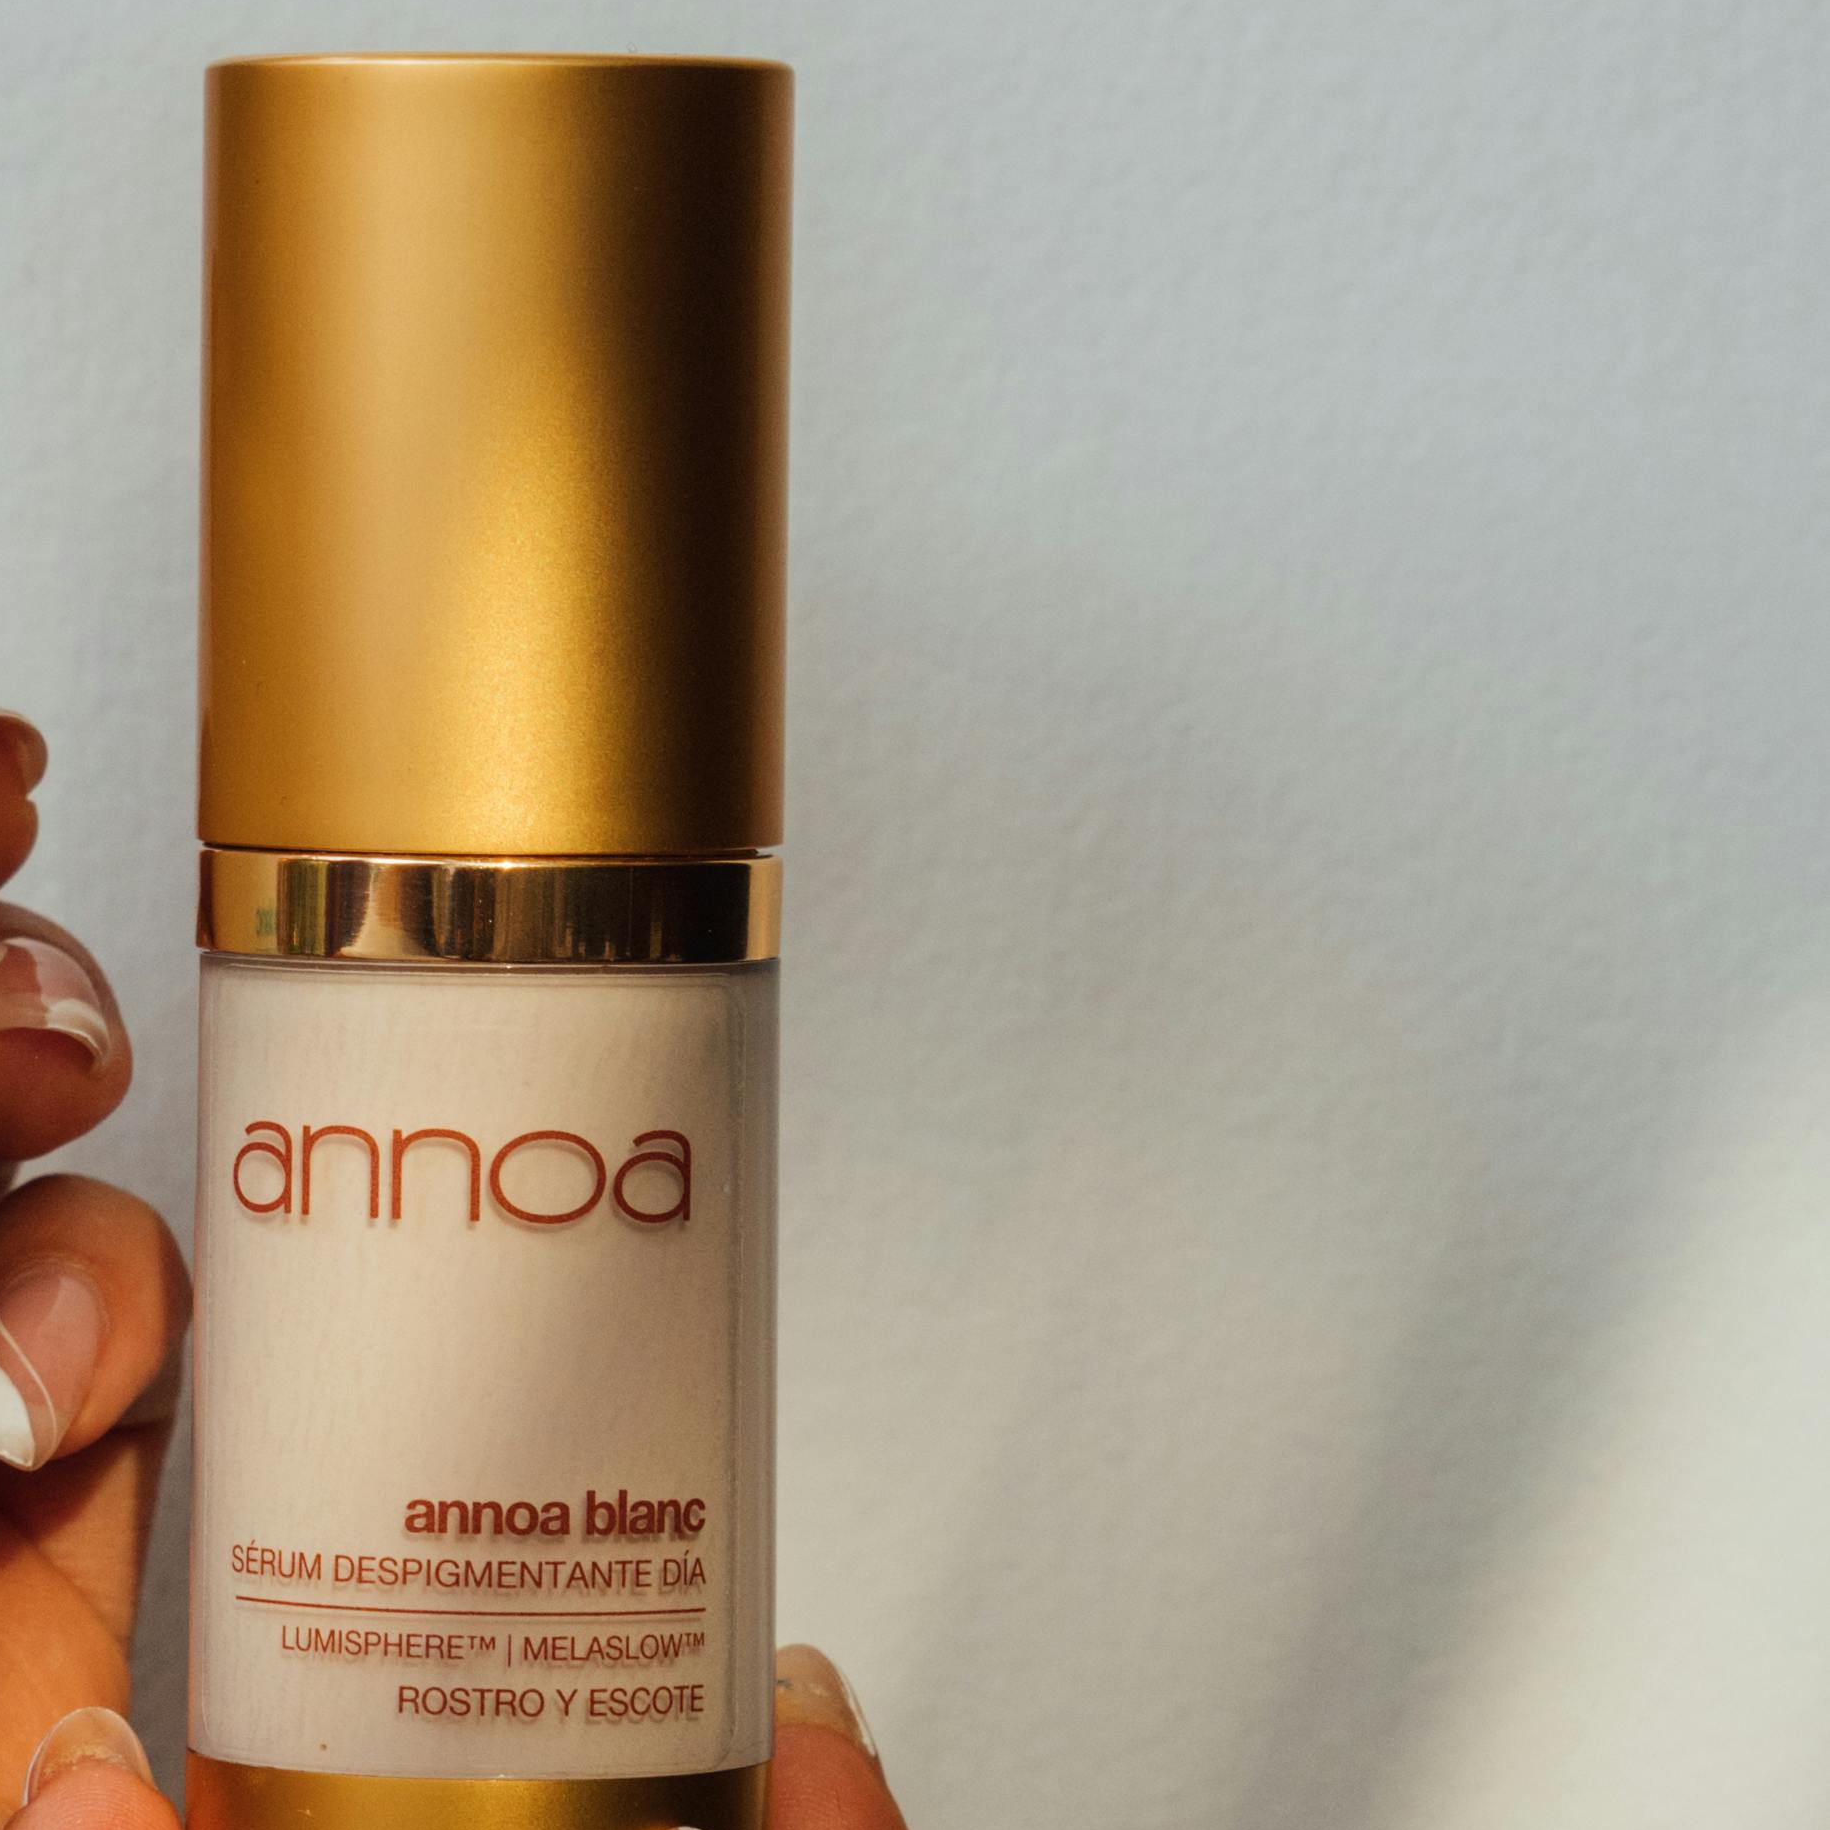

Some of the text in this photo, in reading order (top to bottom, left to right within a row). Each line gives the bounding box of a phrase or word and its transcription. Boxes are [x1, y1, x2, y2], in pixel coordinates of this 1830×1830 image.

[232, 1120, 690, 1224] annoa
[404, 1490, 705, 1535] annoa blanc
[231, 1540, 705, 1588] SÉRUM DESPIGMENTANTE DÍA
[398, 1685, 703, 1715] ROSTRO Y ESCOTE
